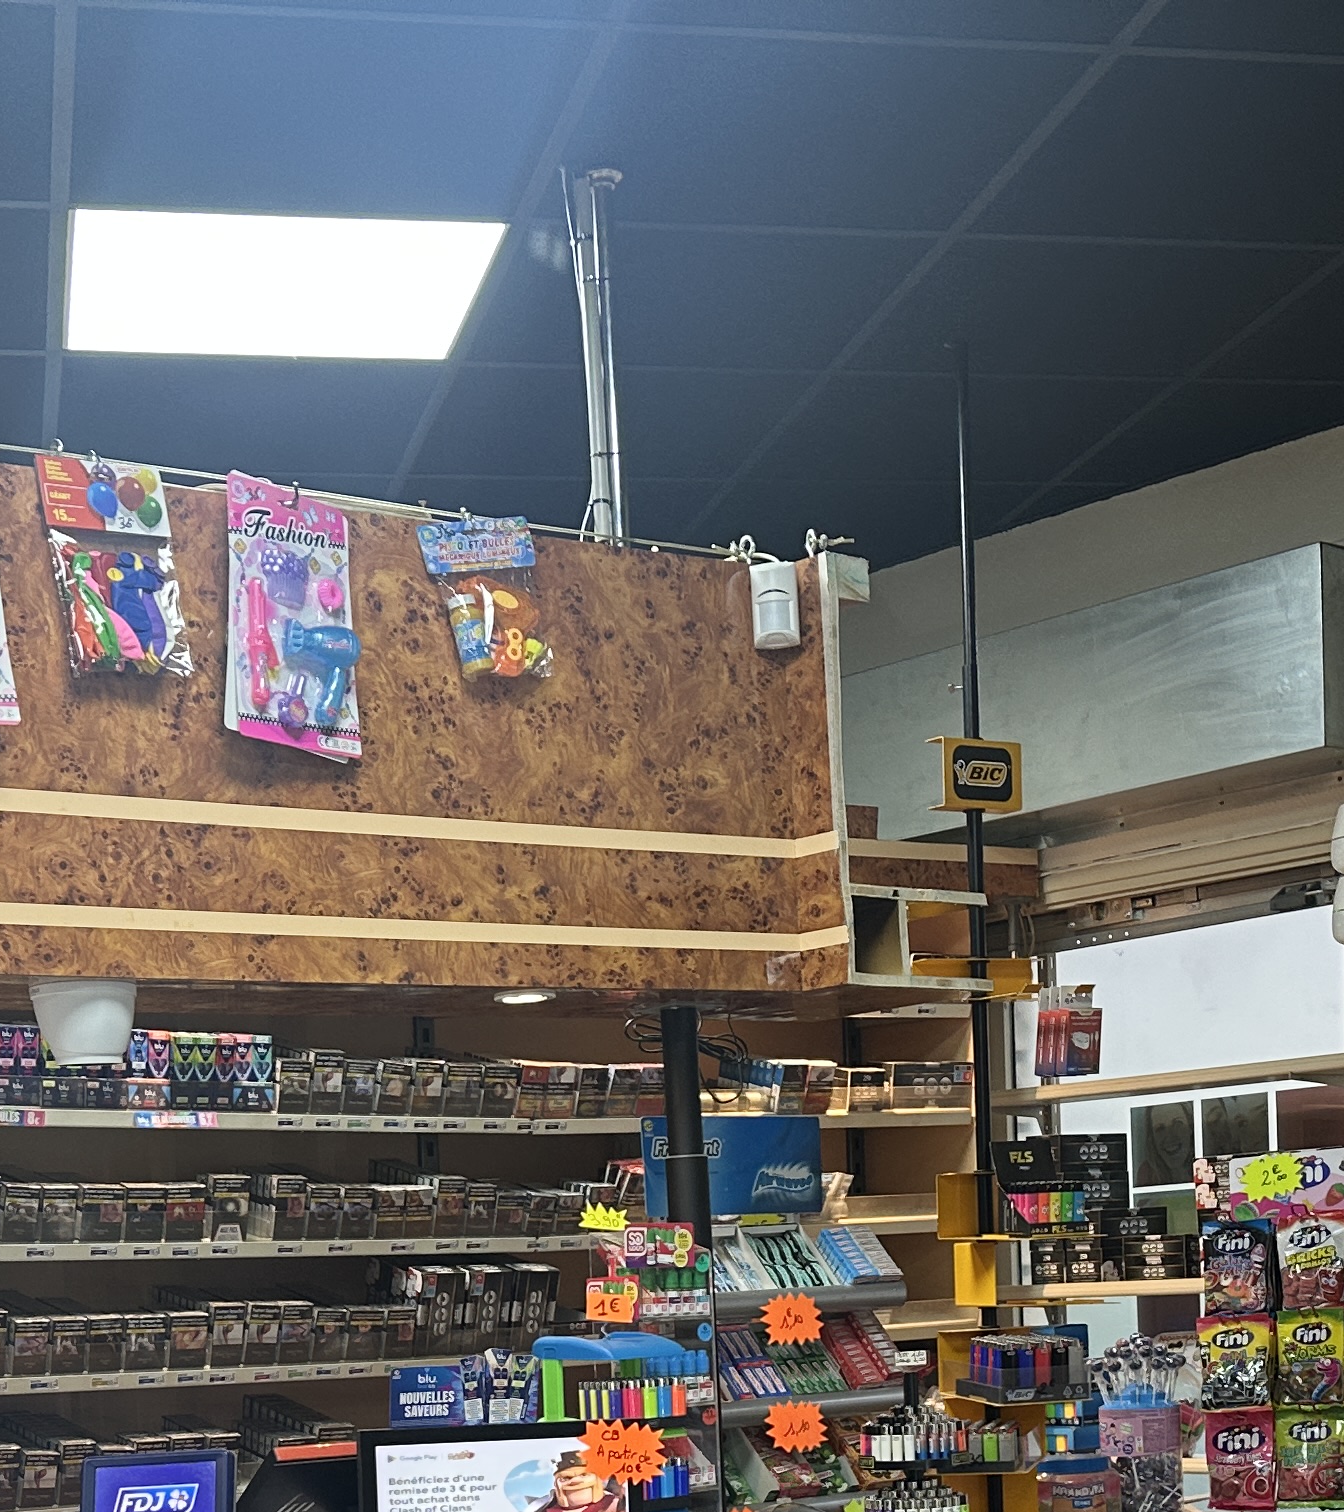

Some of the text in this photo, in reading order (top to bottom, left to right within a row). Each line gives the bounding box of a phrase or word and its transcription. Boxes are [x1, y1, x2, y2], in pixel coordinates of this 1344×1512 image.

[243, 508, 327, 549] Fashion
[969, 766, 1004, 781] BIC
[1009, 1150, 1035, 1164] FLS
[1218, 1232, 1251, 1251] Fini
[1292, 1225, 1328, 1247] Fini
[594, 1297, 621, 1317] 1€
[1216, 1328, 1250, 1348] Fini
[1295, 1324, 1329, 1342] Fini
[417, 1373, 438, 1386] blu
[399, 1390, 456, 1405] NOUVELLES
[404, 1403, 450, 1418] SAVEURS
[601, 1430, 621, 1442] CB
[1216, 1425, 1261, 1451] Fini
[1290, 1420, 1330, 1441] Fini
[608, 1447, 638, 1465] partir
[388, 1475, 455, 1487] Bénéficiez
[388, 1484, 498, 1497] remise de pour
[389, 1493, 481, 1507] tout achat dans
